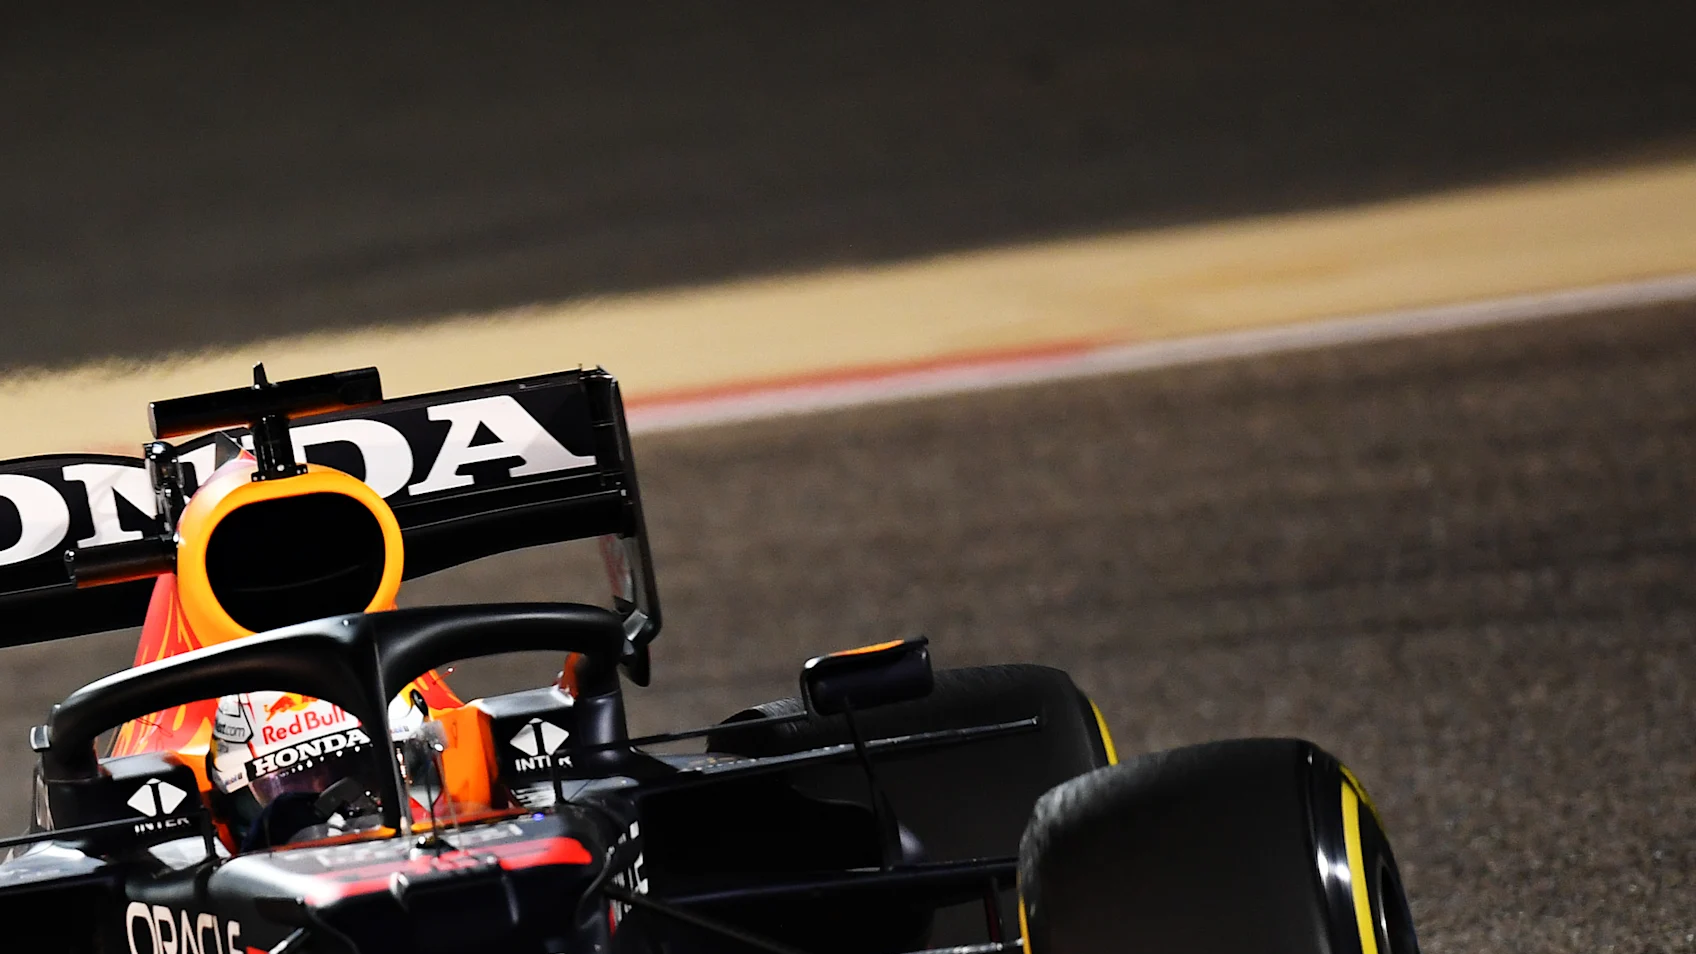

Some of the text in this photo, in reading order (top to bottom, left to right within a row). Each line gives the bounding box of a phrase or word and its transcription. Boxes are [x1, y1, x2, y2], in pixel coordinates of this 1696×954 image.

[261, 704, 347, 745] Red Bull
[252, 728, 371, 777] HONDA
